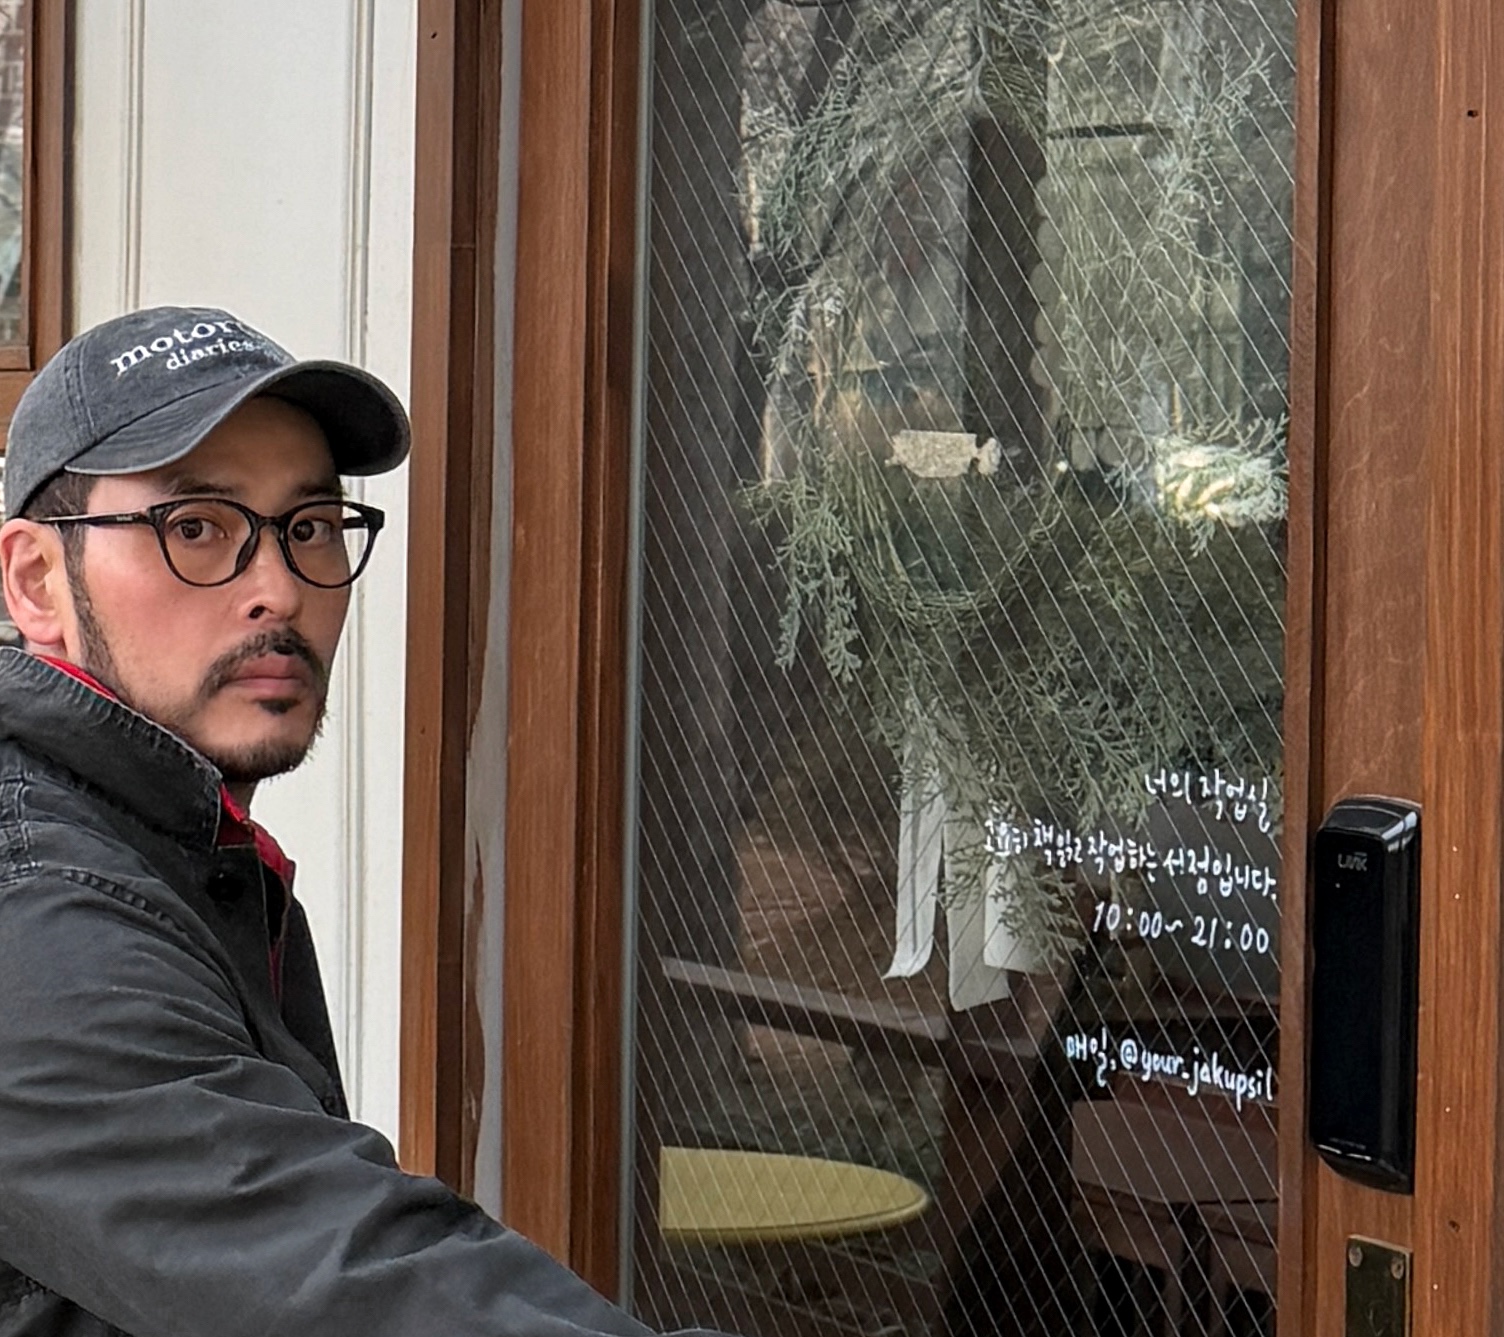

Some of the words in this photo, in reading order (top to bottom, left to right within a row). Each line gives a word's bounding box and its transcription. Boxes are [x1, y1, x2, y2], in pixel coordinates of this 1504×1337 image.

[1145, 768, 1192, 804] 너의
[1199, 768, 1270, 833] 작업실
[1087, 830, 1158, 883] 작업하는
